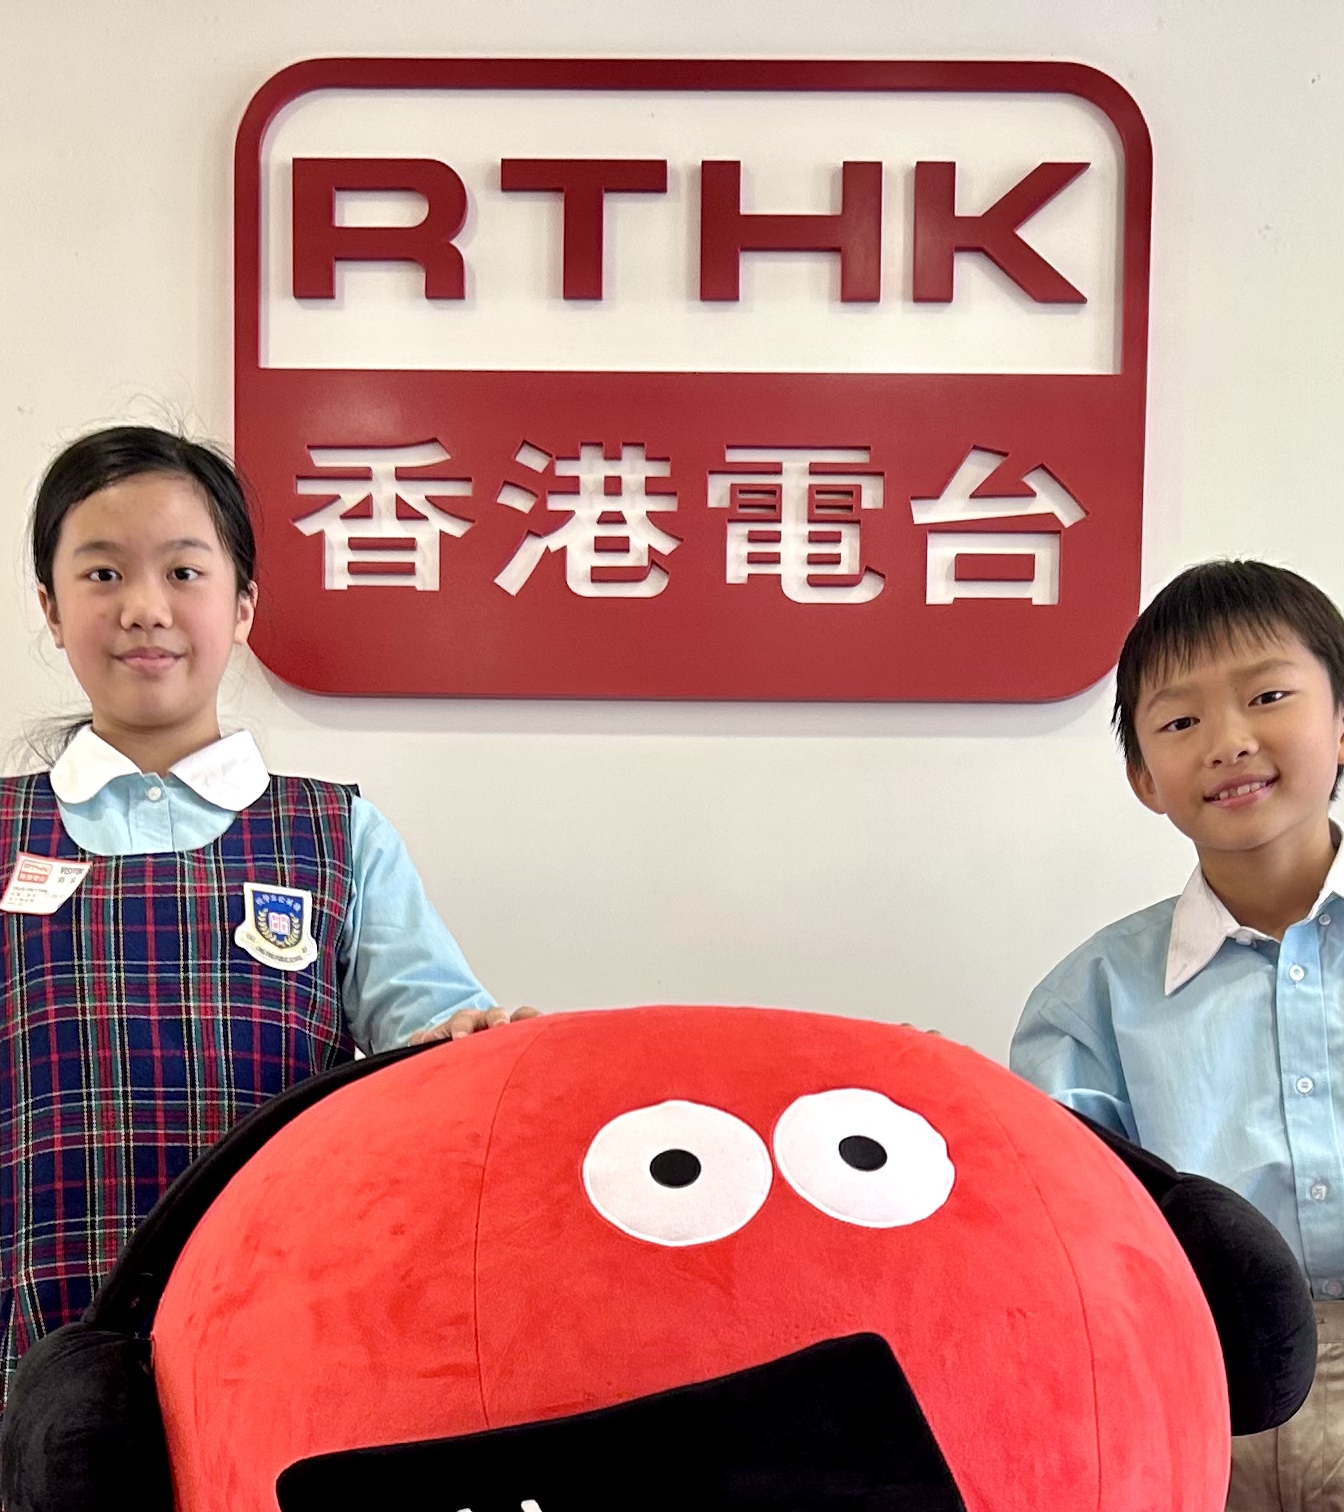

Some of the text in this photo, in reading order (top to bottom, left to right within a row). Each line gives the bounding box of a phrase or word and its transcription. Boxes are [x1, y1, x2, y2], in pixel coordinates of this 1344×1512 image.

[292, 157, 1093, 304] RTHK
[291, 437, 1090, 606] 香港電台
